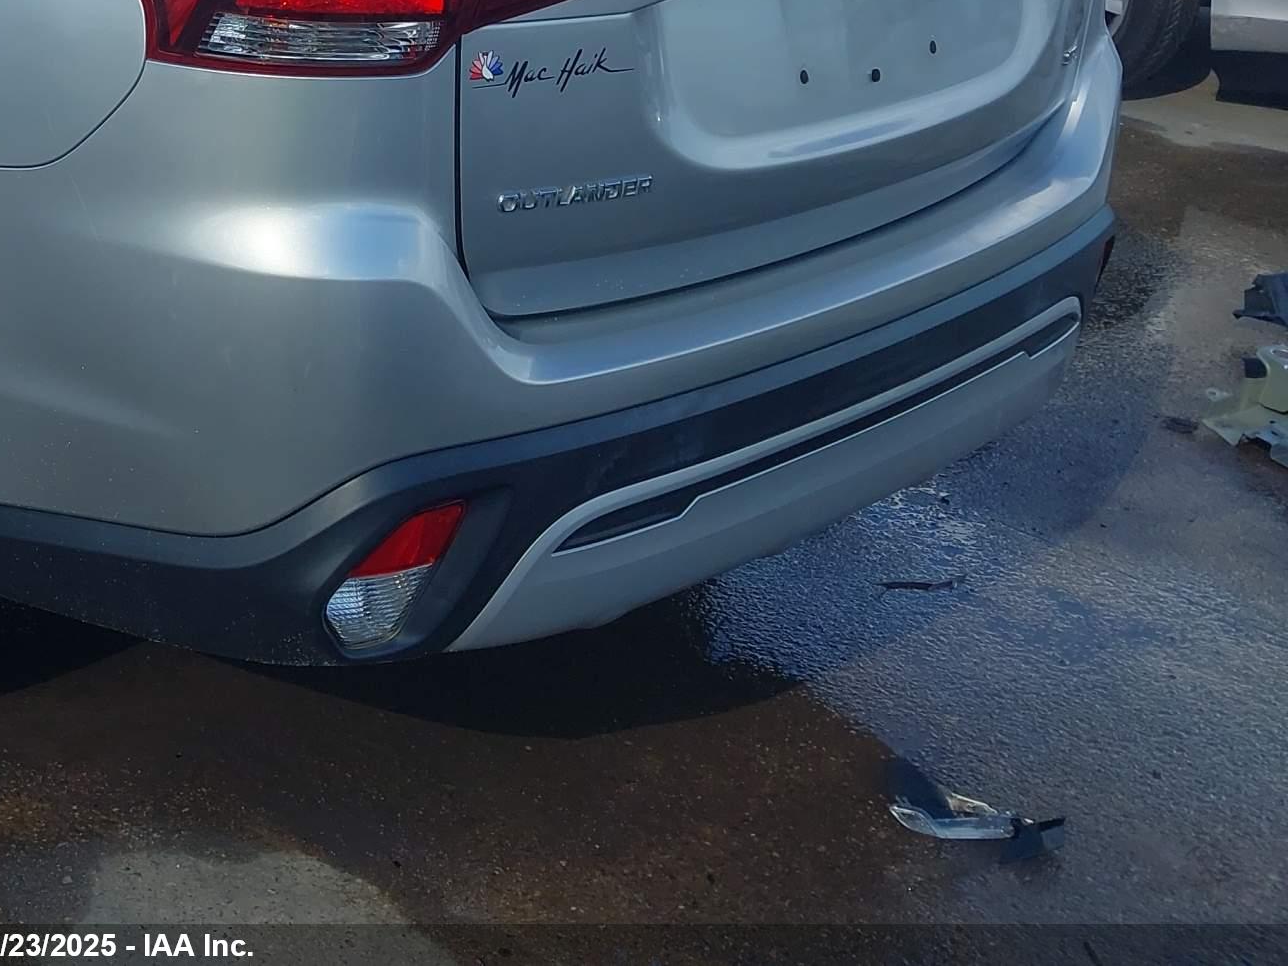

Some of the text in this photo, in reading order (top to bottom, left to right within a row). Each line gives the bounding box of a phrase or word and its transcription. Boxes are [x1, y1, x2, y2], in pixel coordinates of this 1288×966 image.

[501, 47, 634, 99] Mac Haik
[497, 174, 654, 213] OUTLANDER
